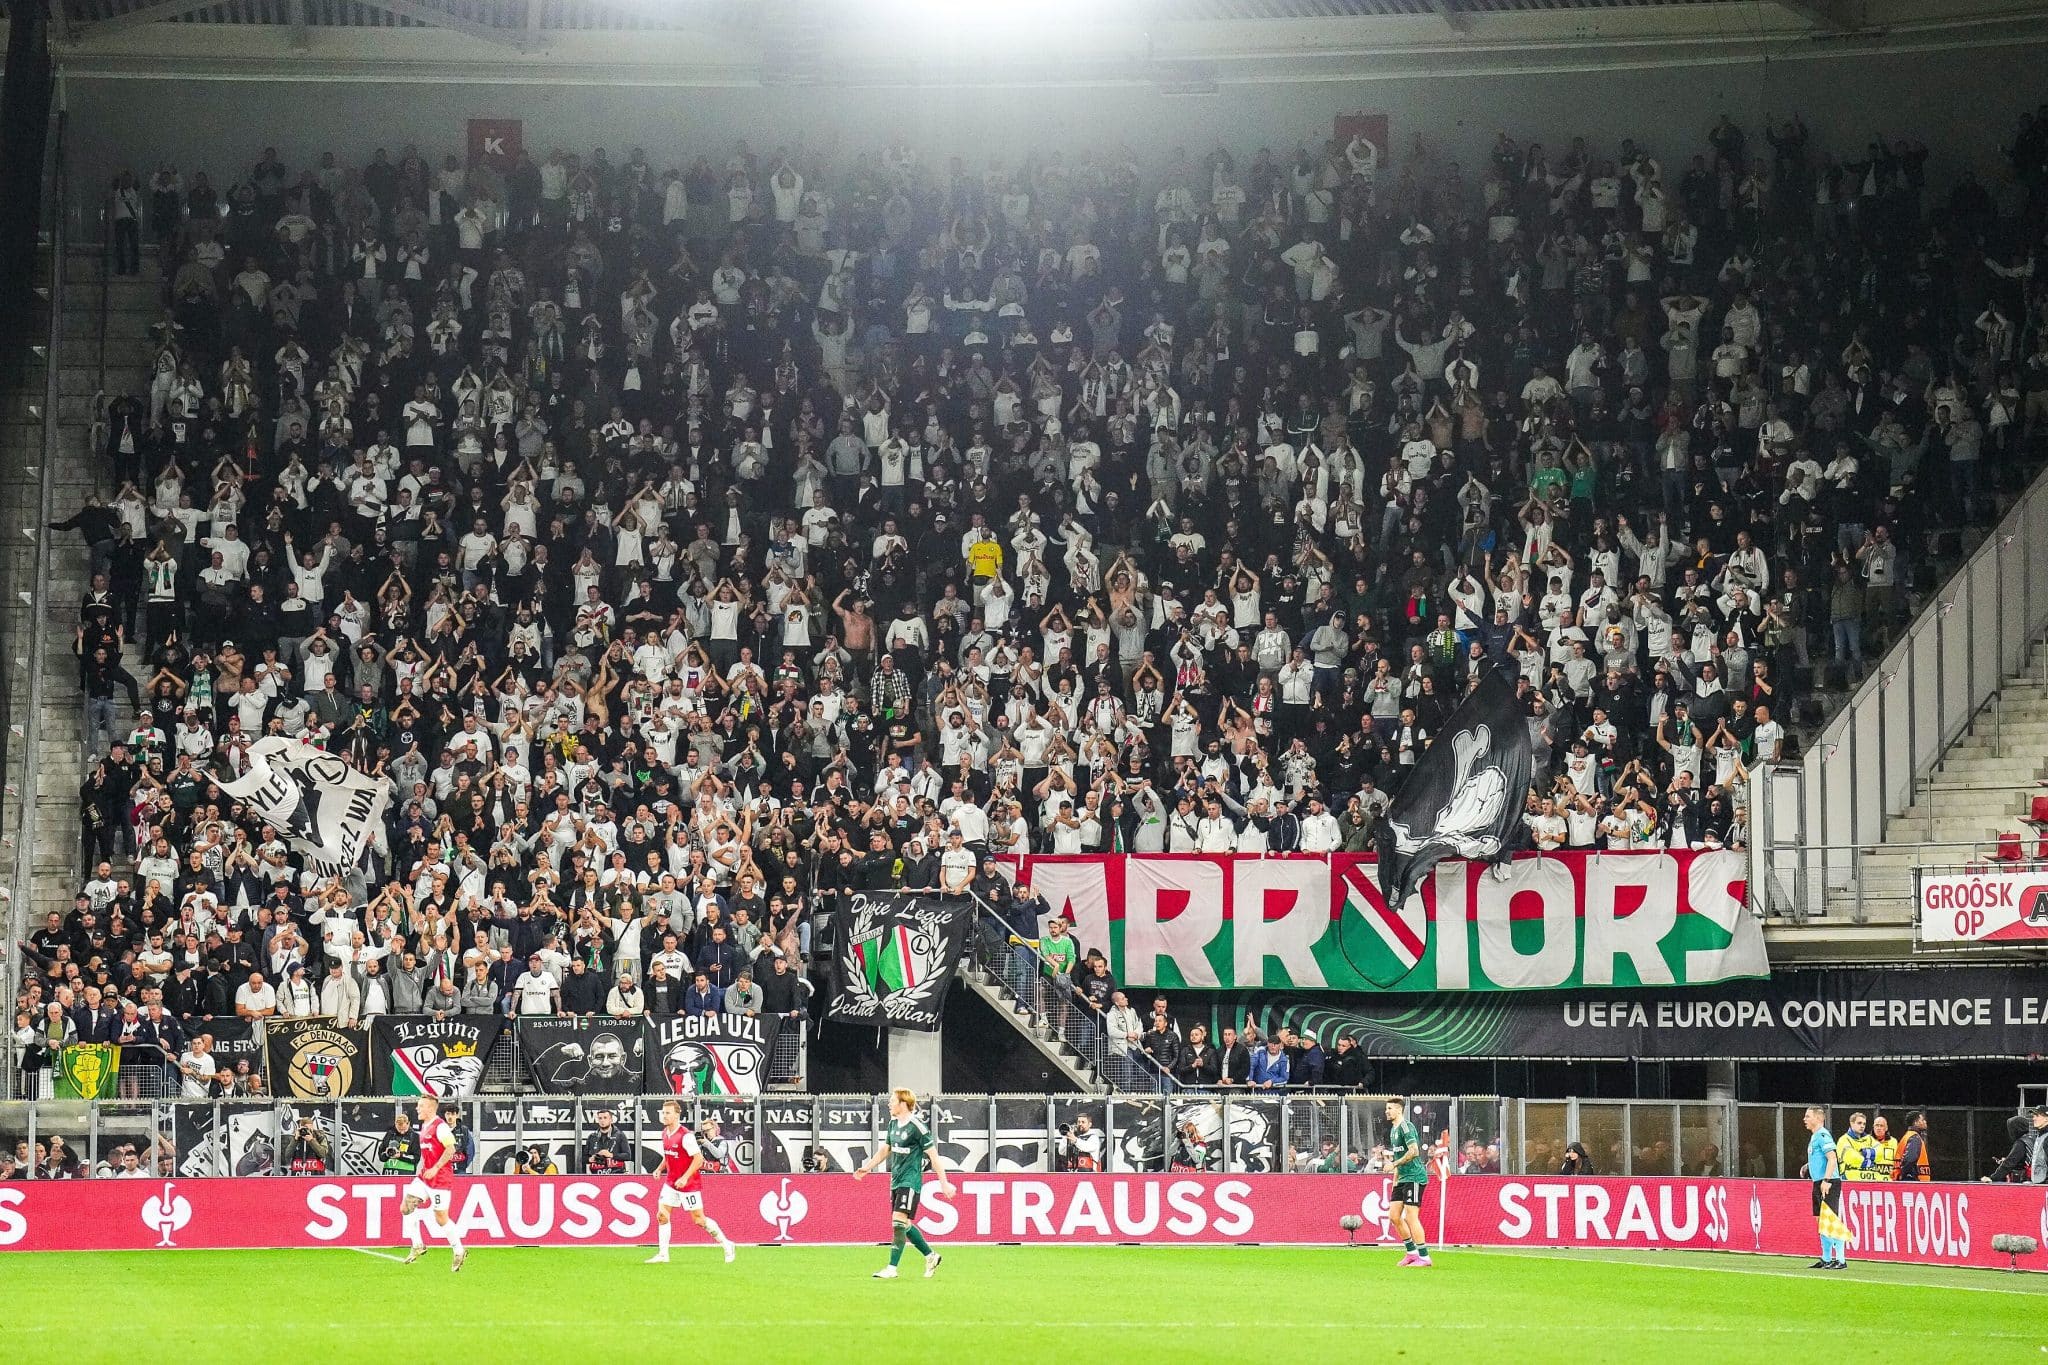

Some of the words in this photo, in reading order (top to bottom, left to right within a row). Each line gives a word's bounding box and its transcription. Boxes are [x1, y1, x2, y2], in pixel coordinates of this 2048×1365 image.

[1926, 877, 2013, 909] GROÔSK
[895, 899, 952, 924] Legie
[1955, 911, 1984, 936] OP
[829, 994, 875, 1017] Jedna
[1563, 1003, 1648, 1028] UEFA
[1657, 1000, 1773, 1027] EUROPA
[1782, 999, 1991, 1028] CONFERENCE
[394, 1020, 480, 1044] Legijna
[660, 1015, 720, 1045] LEGIA
[918, 1180, 1254, 1238] STRAUSS
[1498, 1182, 1728, 1242] STRAUSS
[1902, 1191, 1971, 1258] TOOLS
